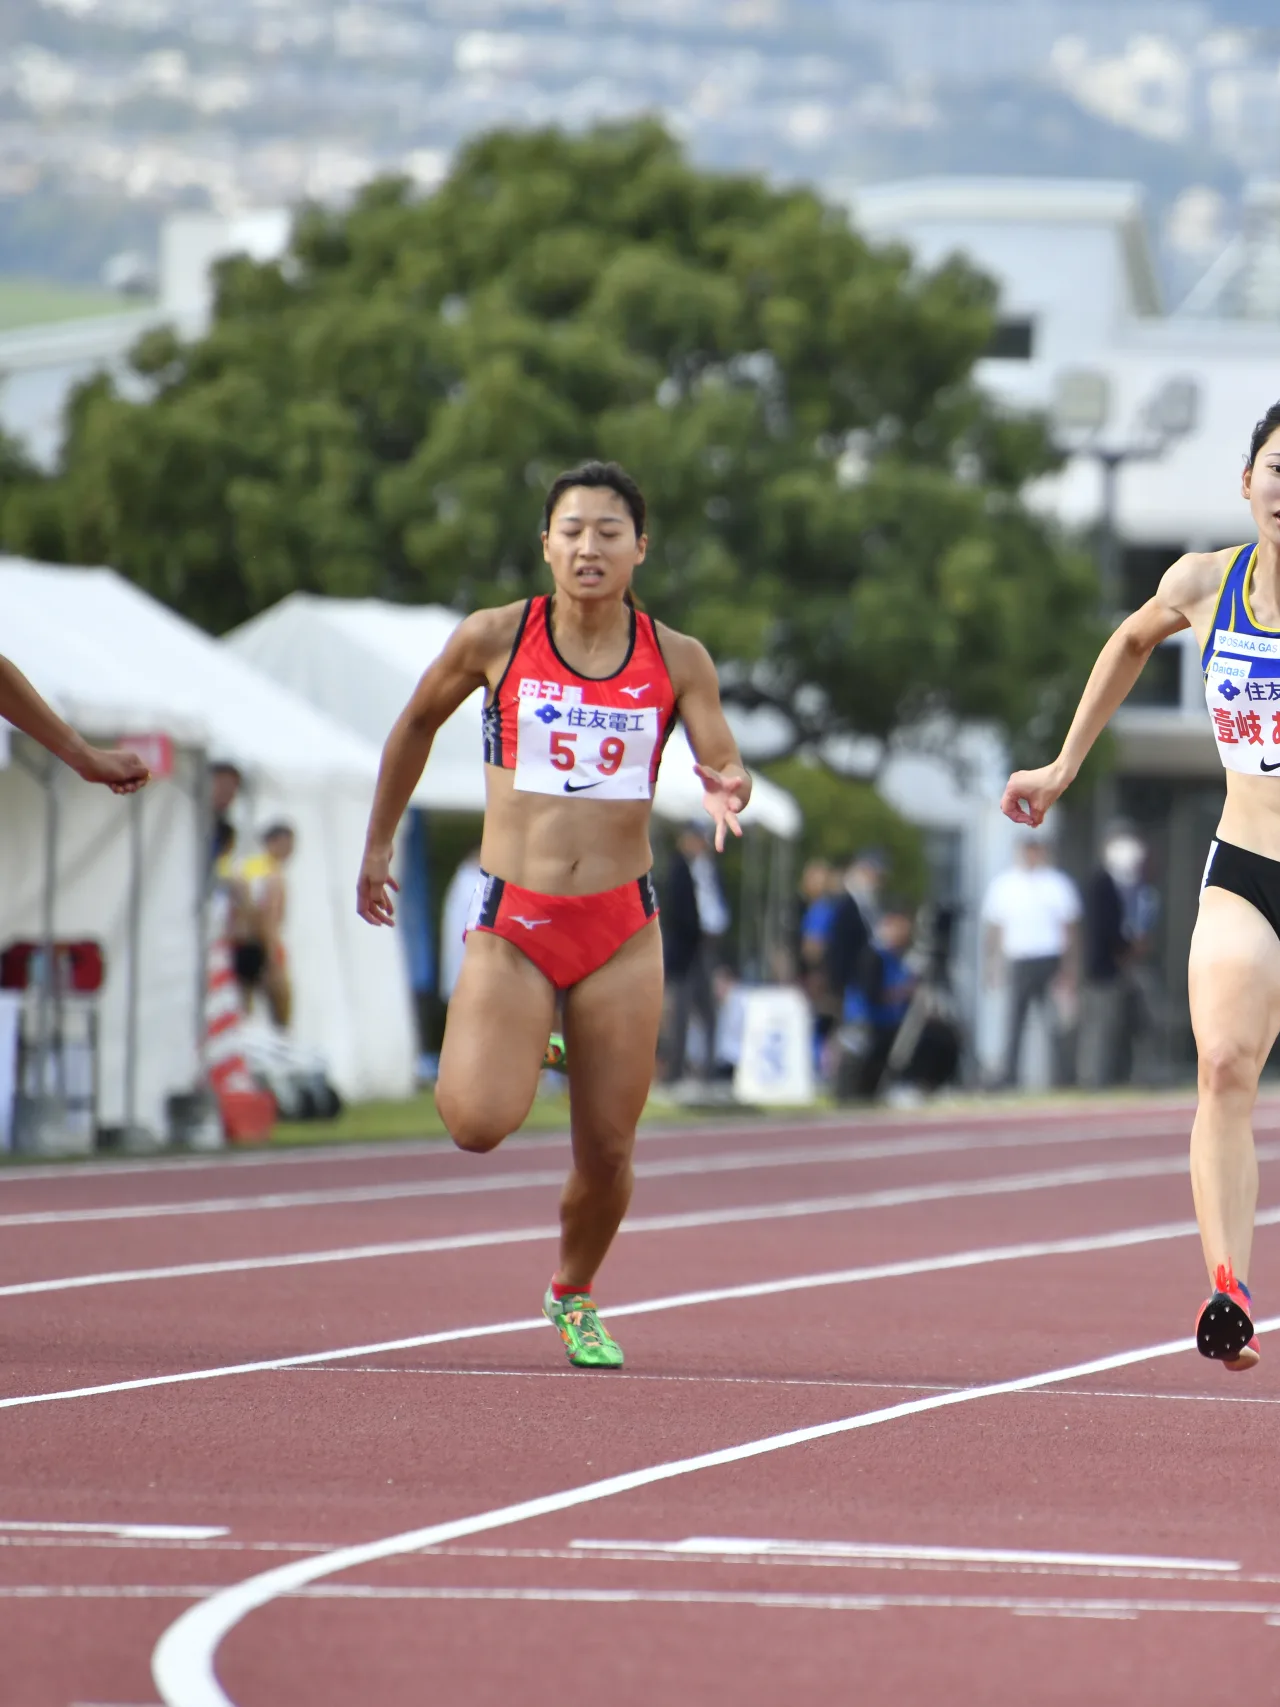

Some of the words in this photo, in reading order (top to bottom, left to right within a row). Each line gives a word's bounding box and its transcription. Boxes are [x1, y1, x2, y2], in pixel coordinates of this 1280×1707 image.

[1227, 637, 1255, 651] OSAKA
[1258, 643, 1278, 653] GAS
[567, 707, 645, 732] 住友電工
[549, 731, 626, 776] 59
